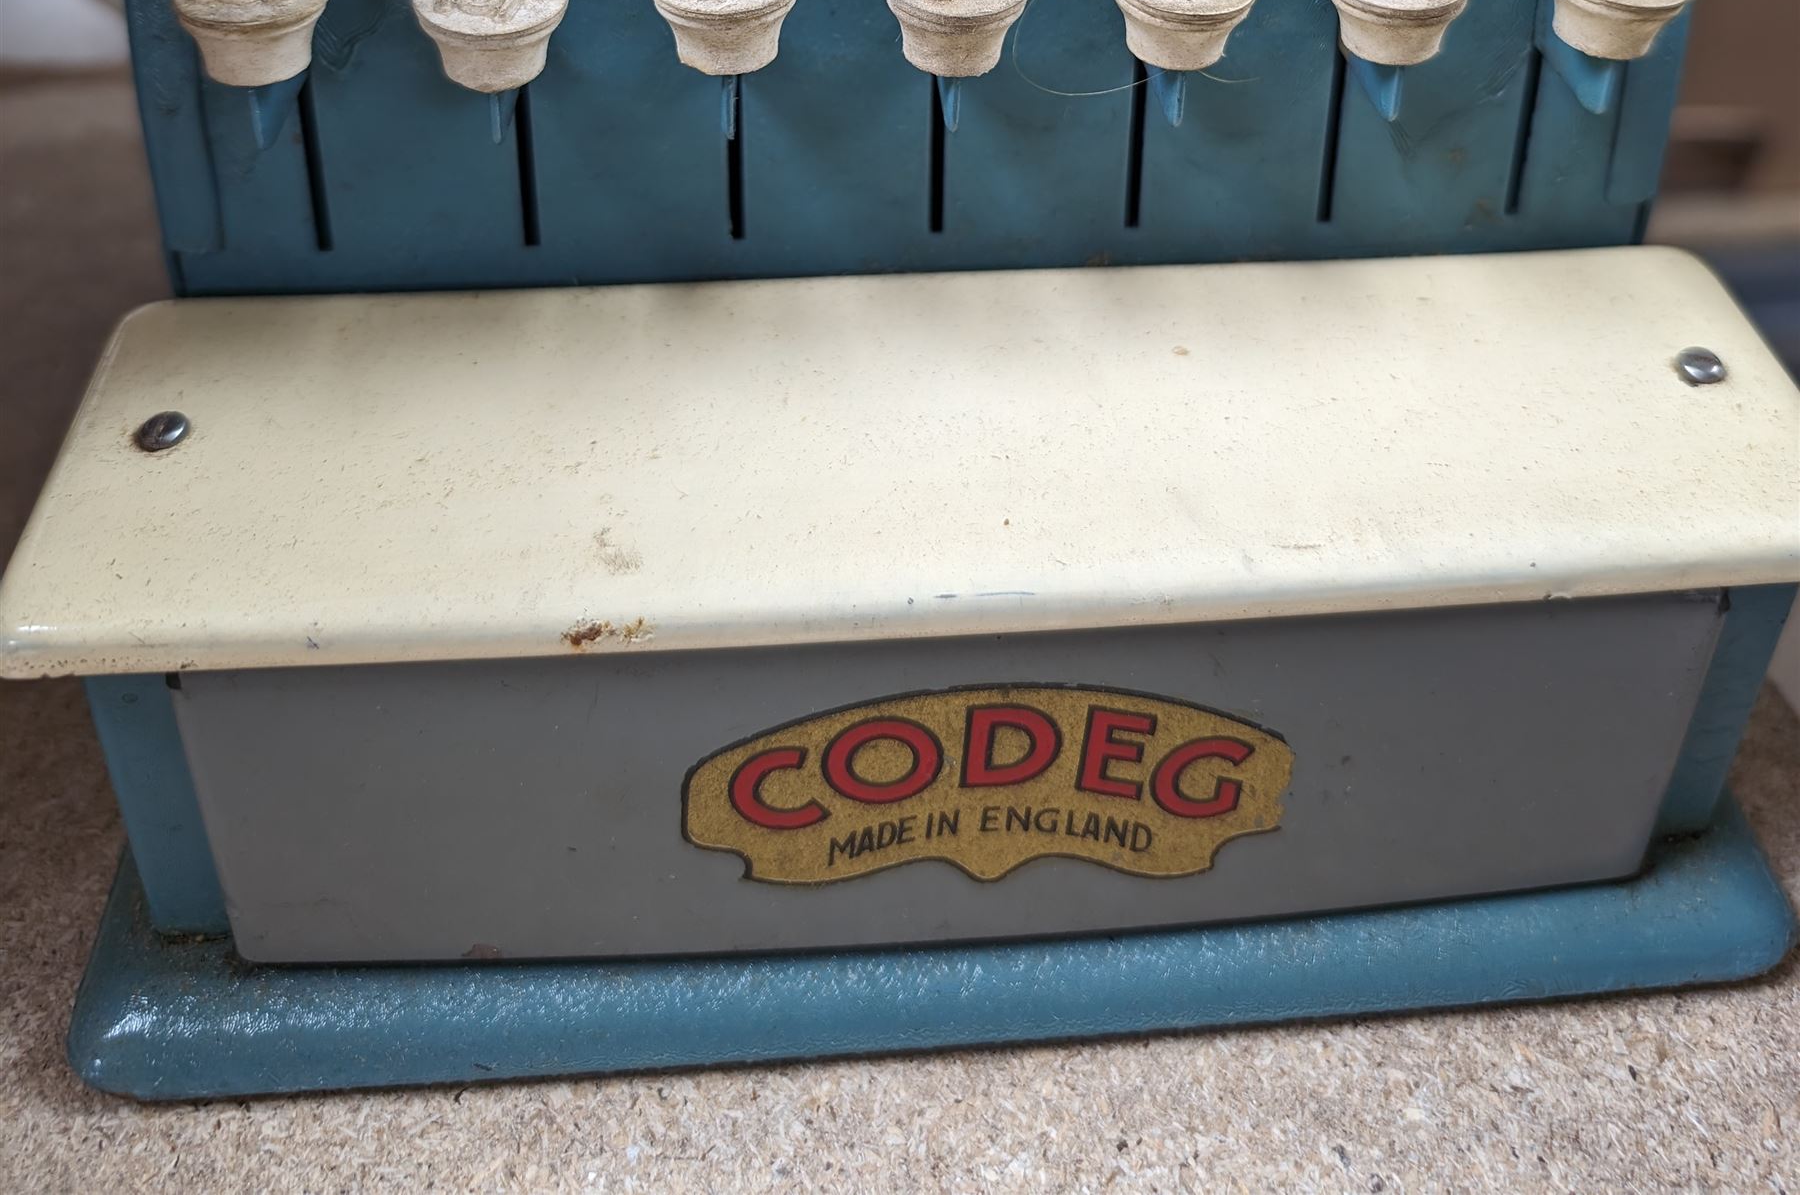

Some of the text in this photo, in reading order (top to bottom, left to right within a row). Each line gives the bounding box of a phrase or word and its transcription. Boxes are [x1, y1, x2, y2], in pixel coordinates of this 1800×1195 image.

[728, 703, 1257, 830] CODEG
[828, 805, 1155, 867] MADE IN ENGLAND
